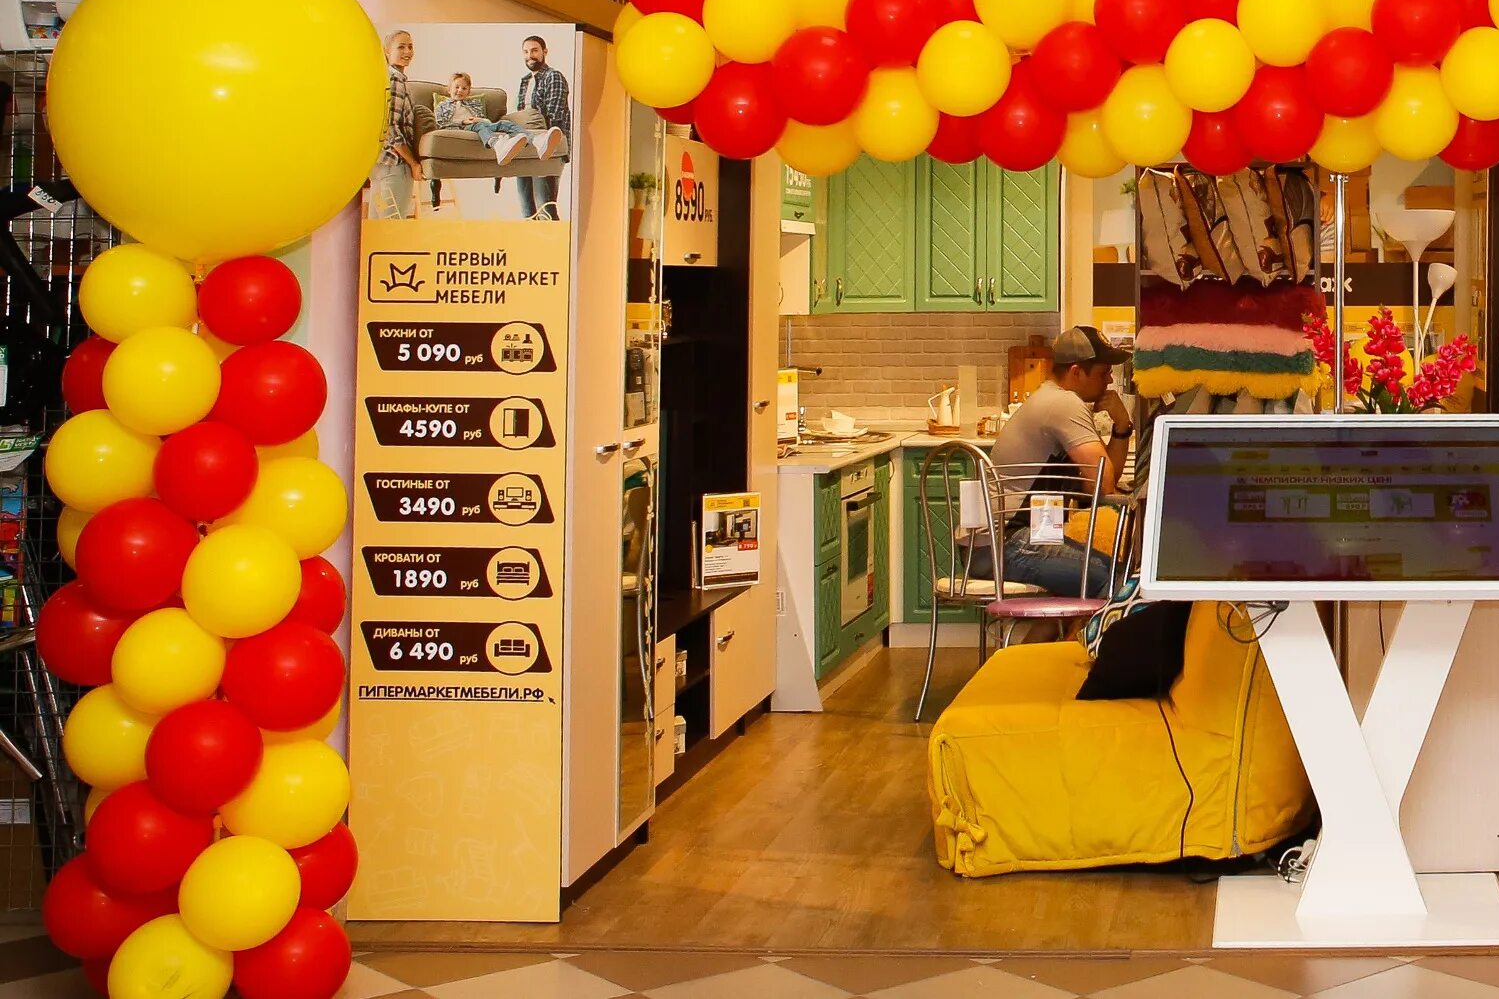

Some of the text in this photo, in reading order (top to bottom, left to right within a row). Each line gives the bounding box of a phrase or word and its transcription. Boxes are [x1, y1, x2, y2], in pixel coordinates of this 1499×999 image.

[436, 249, 507, 266] ПЕРВЫЙ
[436, 271, 560, 286] ГИПЕРМАРКЕТ
[436, 290, 506, 304] МЕБЕЛИ
[379, 329, 434, 338] КУХНИ ОТ
[397, 343, 484, 365] 5 090 руб
[378, 404, 470, 414] ШКАФЫ-КУПЕ ОТ
[400, 419, 482, 440] 4590 руб
[376, 479, 450, 489] ГОСТИНЫЕ ОТ
[399, 497, 481, 516] 3490 руб
[374, 553, 441, 563] КРОВАТИ ОТ
[394, 570, 479, 590] 1890 руб
[373, 628, 440, 639] ДИВАНЫ ОТ
[389, 642, 478, 665] 6 490 руб
[359, 685, 544, 700] ГИПЕРМАРКЕТМЕБЕЛИ.РФ
